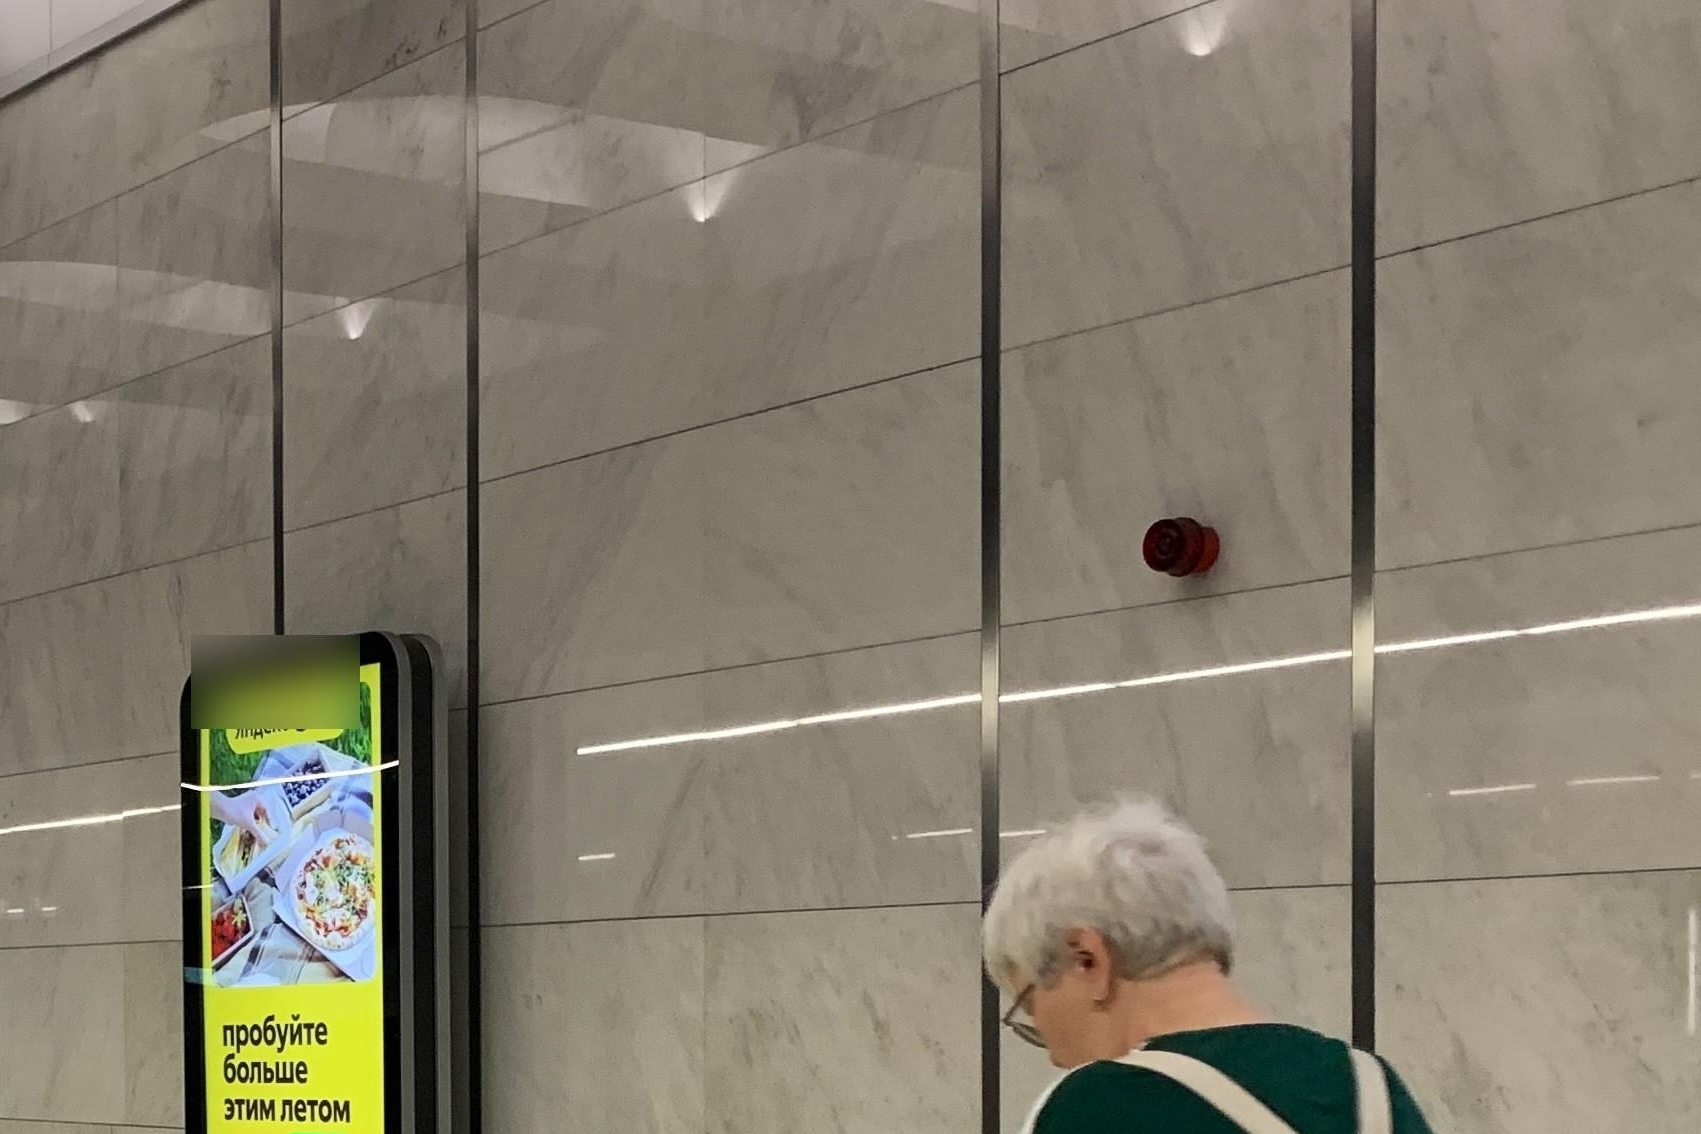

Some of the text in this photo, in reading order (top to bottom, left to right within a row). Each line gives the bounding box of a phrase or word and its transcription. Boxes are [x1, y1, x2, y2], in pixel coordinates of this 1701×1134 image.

[223, 1014, 328, 1053] пробуйте
[223, 1053, 308, 1084] больше
[224, 1097, 351, 1123] этим летом
